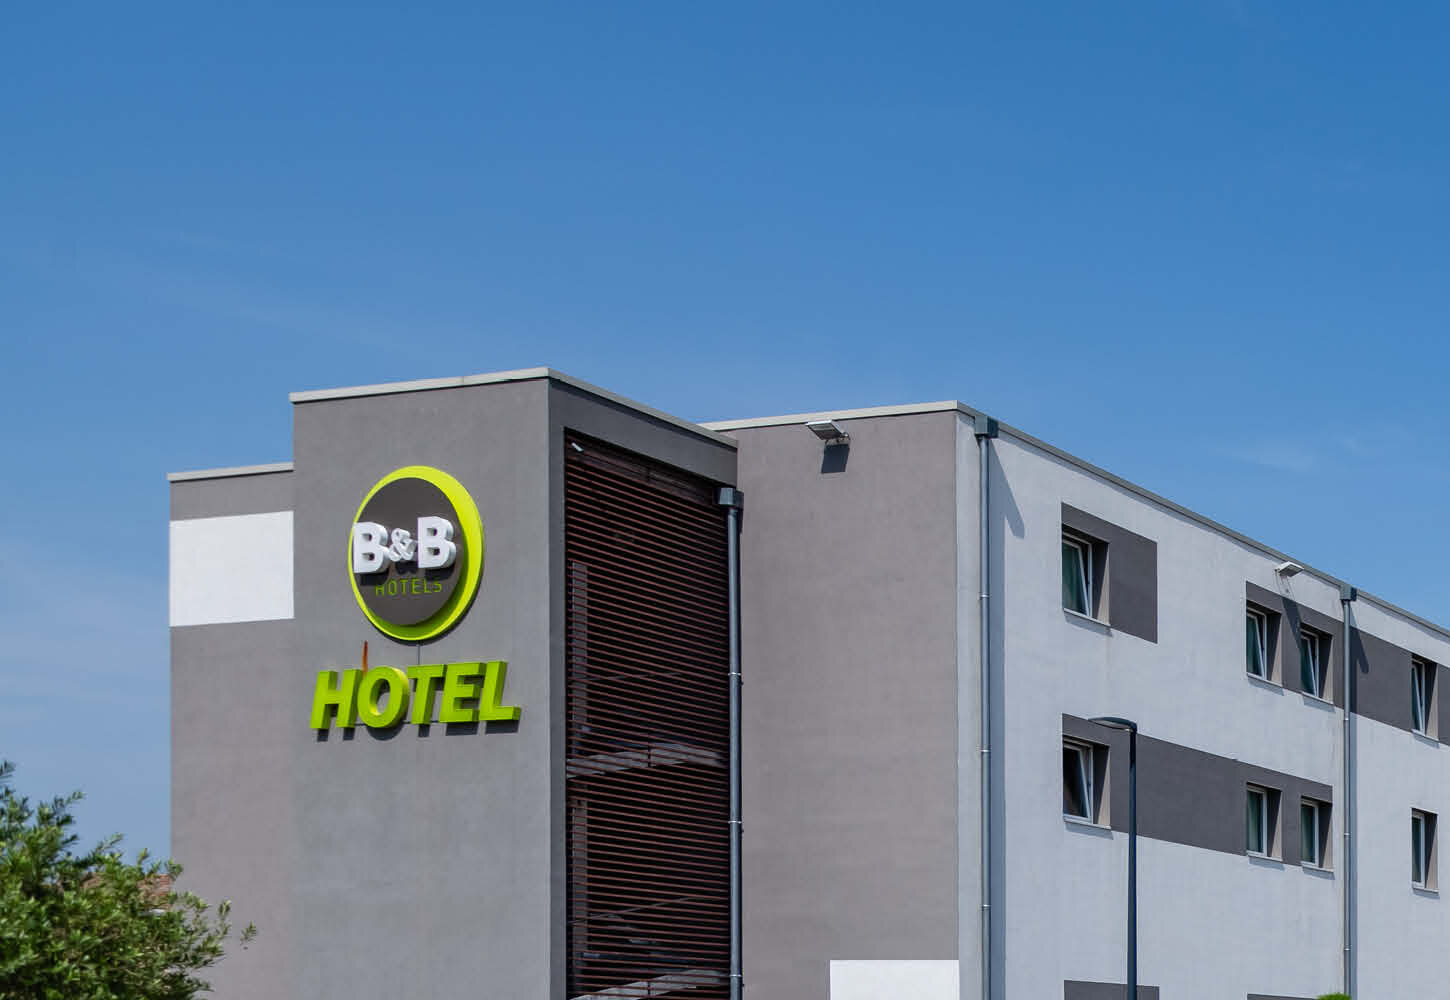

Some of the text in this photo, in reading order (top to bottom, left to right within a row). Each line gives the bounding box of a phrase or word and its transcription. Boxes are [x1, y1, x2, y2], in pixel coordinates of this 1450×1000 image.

[352, 516, 457, 573] B&B
[375, 578, 442, 597] HOTELS
[310, 661, 521, 729] HOTEL
